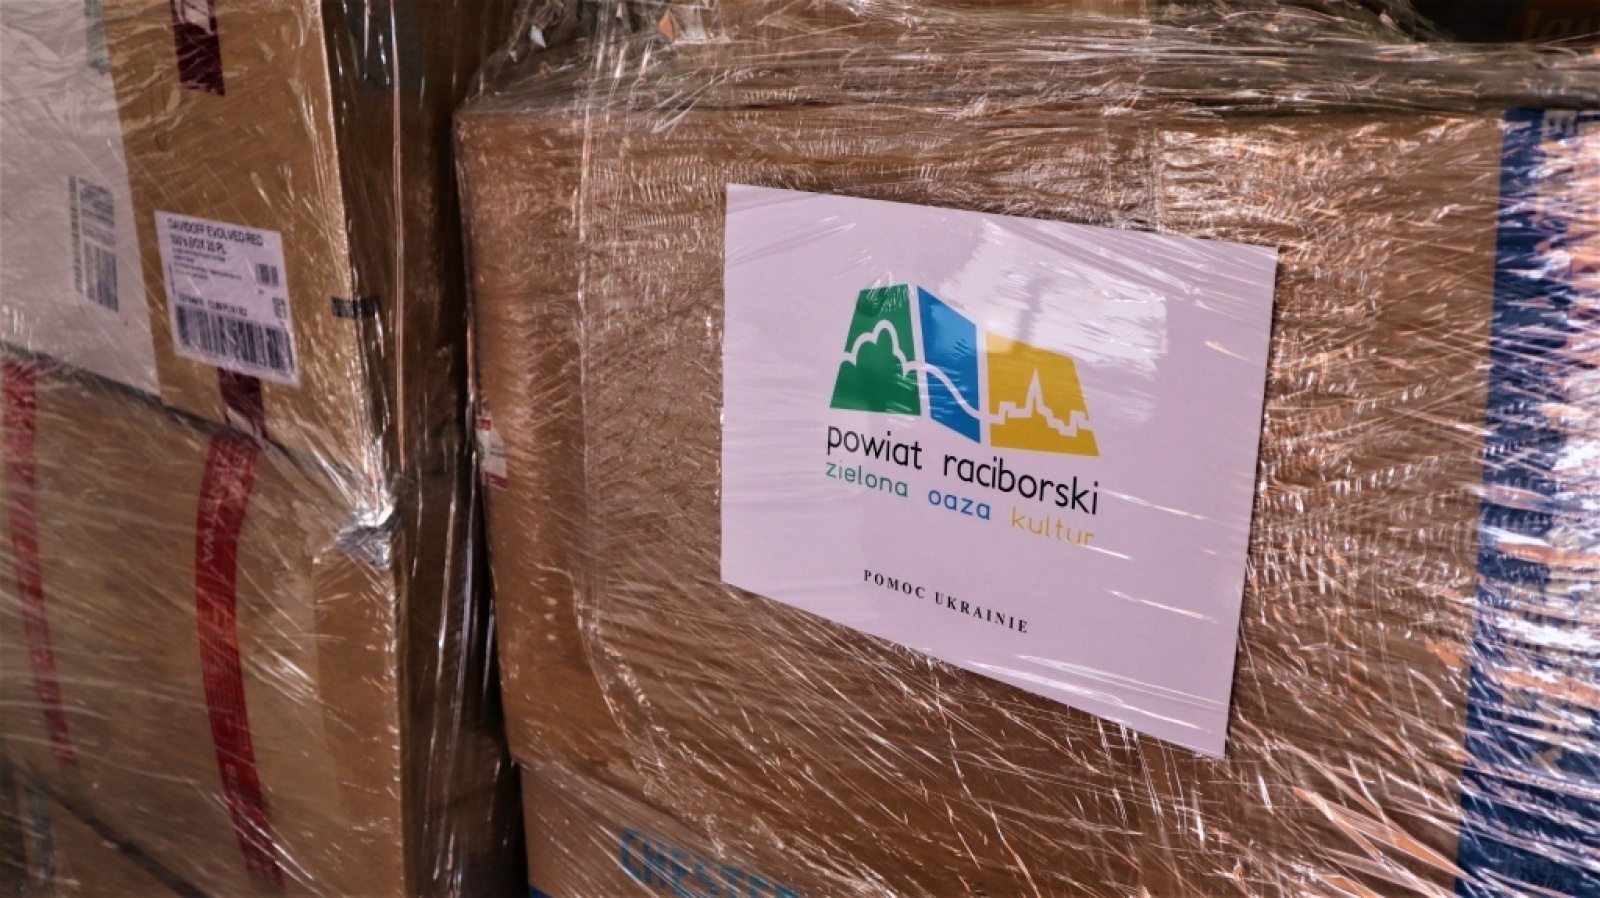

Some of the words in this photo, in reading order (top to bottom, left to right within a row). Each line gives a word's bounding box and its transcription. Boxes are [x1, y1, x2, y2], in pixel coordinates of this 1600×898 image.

[205, 225, 245, 243] EVOLVED
[245, 232, 264, 247] RED
[825, 461, 909, 498] zielona
[927, 489, 992, 521] oaza
[1011, 506, 1095, 547] kultur
[827, 425, 923, 470] powiat
[943, 454, 1100, 516] raciborski
[863, 569, 926, 599] POMOC
[935, 592, 1029, 634] UKRAINIE
